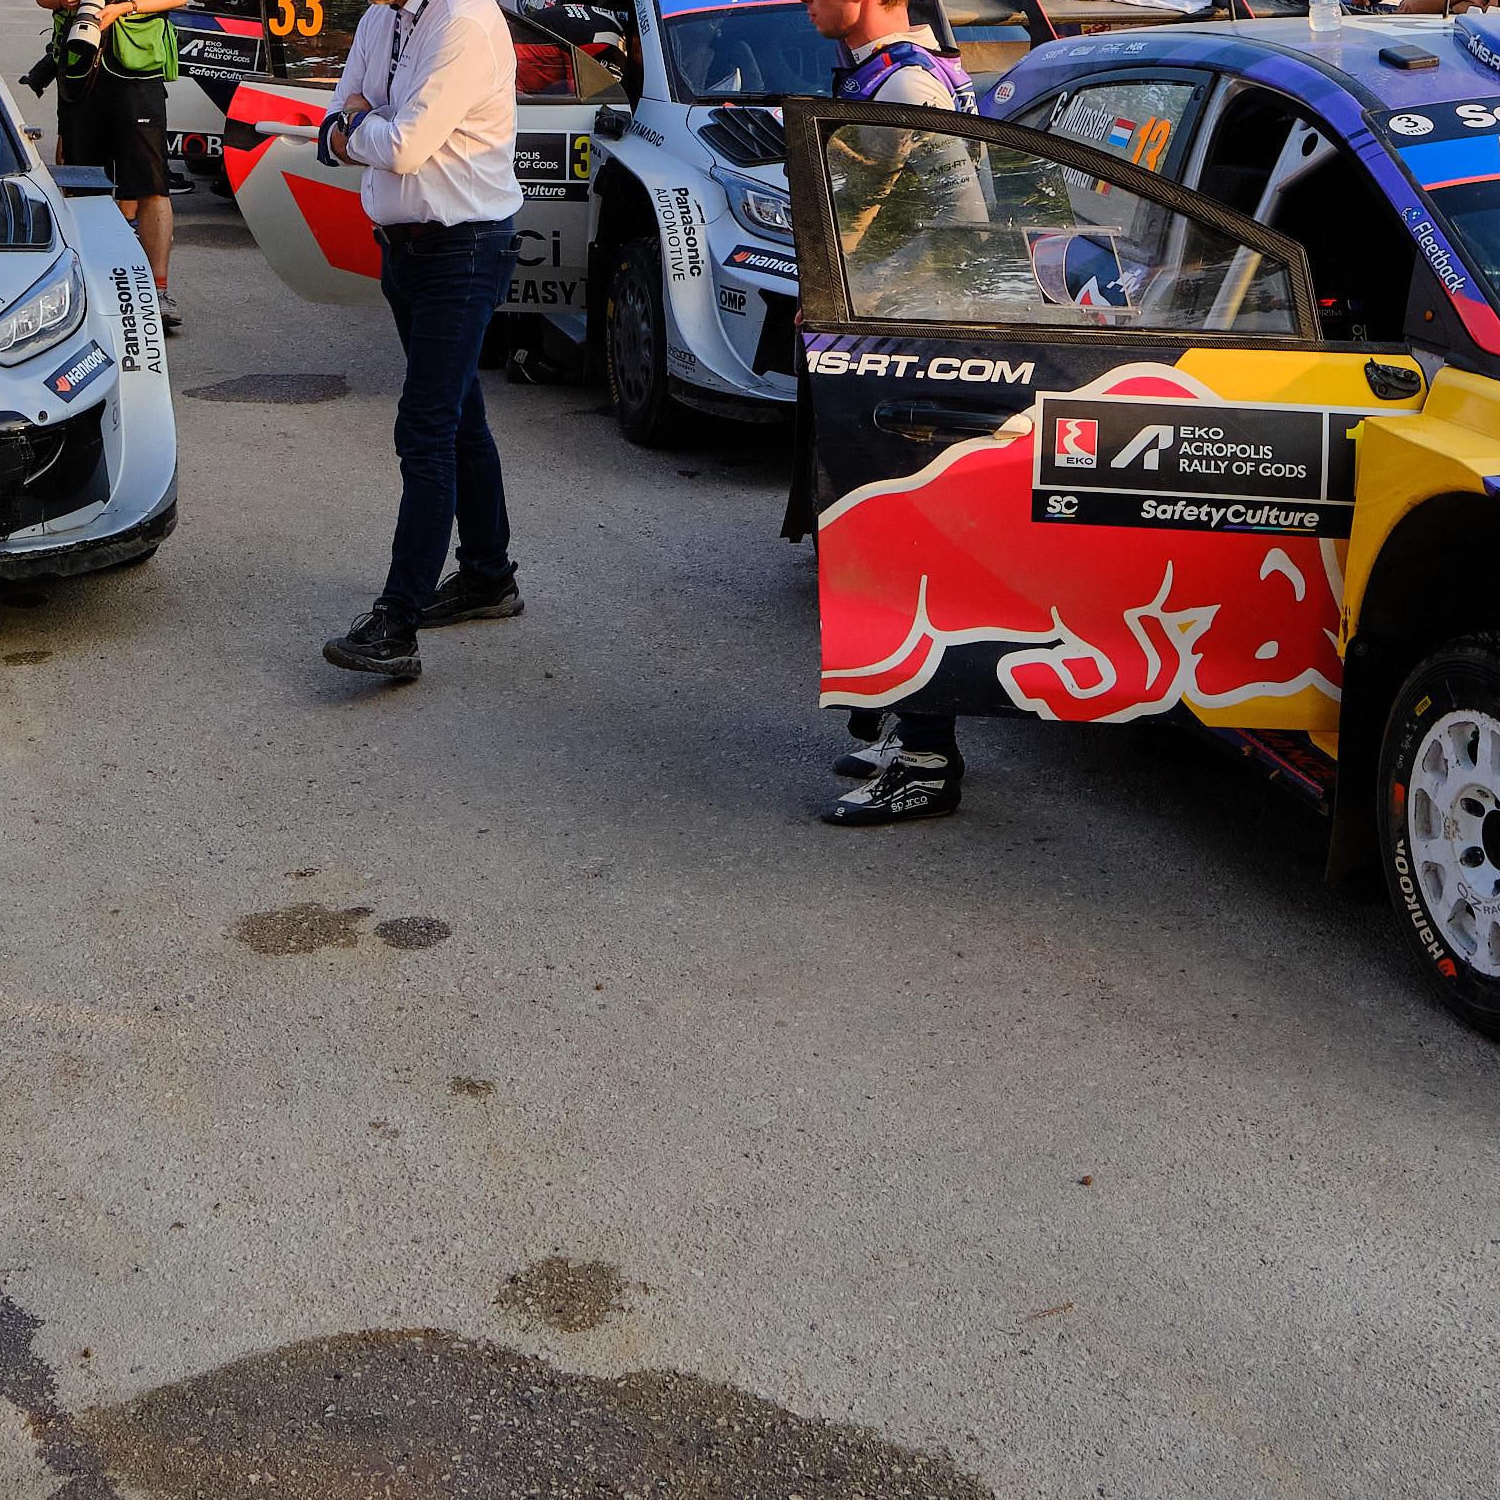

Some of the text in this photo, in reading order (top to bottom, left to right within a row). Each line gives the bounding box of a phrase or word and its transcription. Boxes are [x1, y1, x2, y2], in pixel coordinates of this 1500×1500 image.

[203, 52, 251, 64] RALLY OF GODS
[188, 66, 243, 81] SafetyCultu
[1063, 94, 1116, 141] Munster
[1398, 113, 1420, 129] 3
[166, 133, 224, 157] MOB
[630, 119, 666, 148] TAMADIC
[1132, 116, 1172, 172] 13
[515, 151, 541, 160] POLIS
[518, 161, 559, 169] OF GODS
[573, 135, 591, 179] 3
[520, 184, 567, 197] Culture
[654, 188, 686, 282] AUTOMOTIVE
[672, 187, 705, 278] Panasonic
[515, 229, 561, 268] Ci
[1412, 220, 1467, 295] Fleetback
[745, 253, 798, 275] Hanko
[719, 290, 747, 312] OMP
[108, 266, 141, 373] Panasonic
[131, 264, 162, 374] AUTOMOTIVE
[1180, 426, 1225, 439] EKO
[1066, 456, 1094, 466] EKO
[1179, 443, 1273, 460] ACROPOLIS
[1179, 458, 1307, 479] RALLY OF GODS
[1046, 494, 1320, 529] SC SafetyCulture
